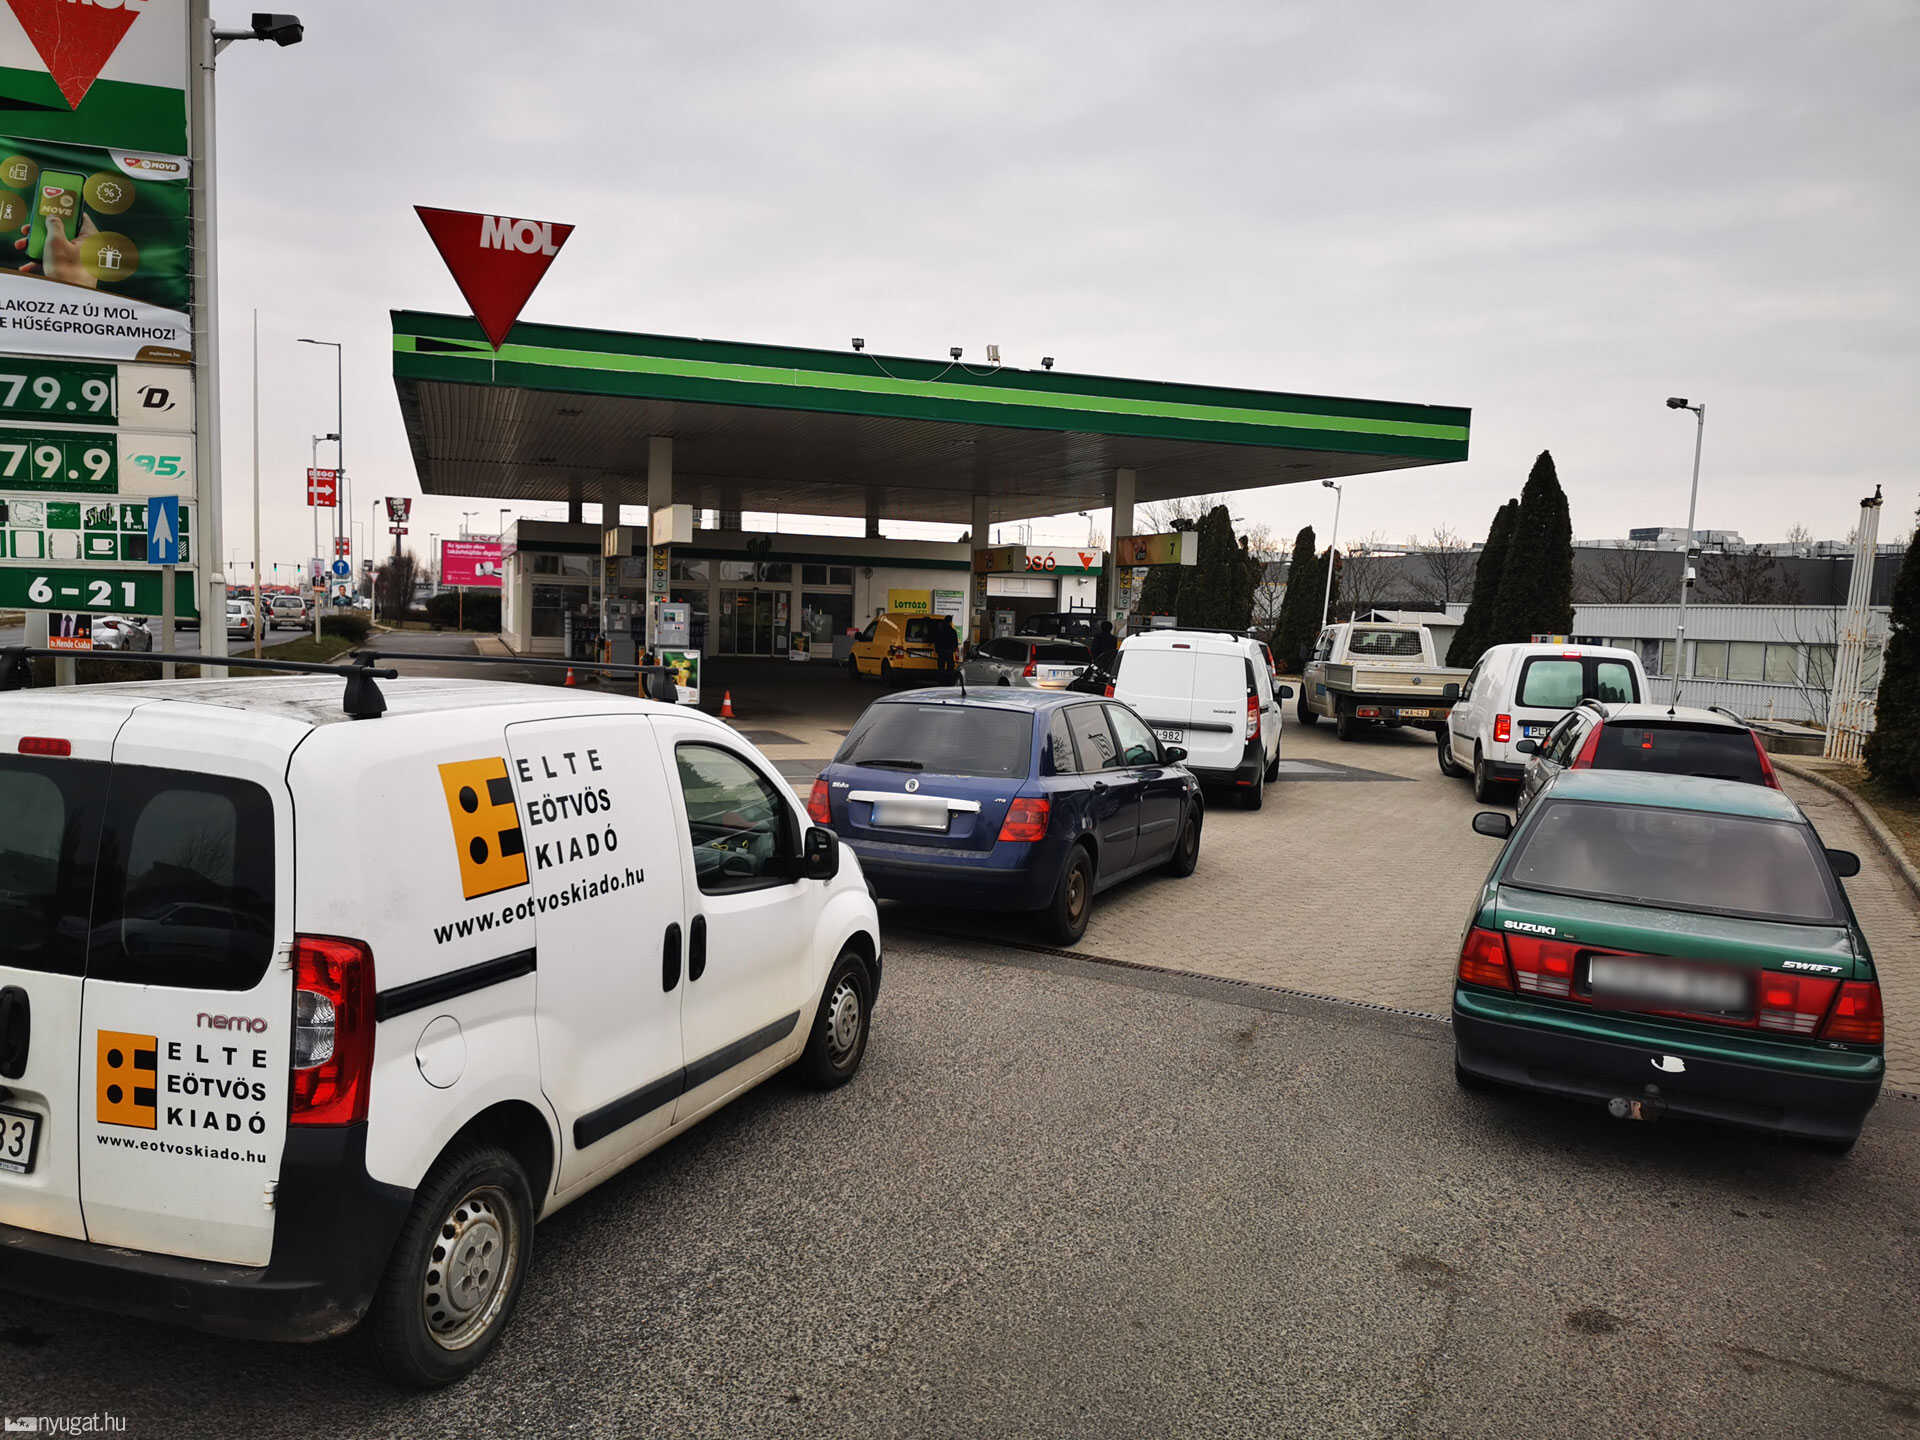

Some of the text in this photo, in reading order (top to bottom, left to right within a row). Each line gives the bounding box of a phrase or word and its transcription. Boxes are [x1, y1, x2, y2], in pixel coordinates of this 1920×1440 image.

[480, 215, 561, 257] MOL
[59, 303, 78, 317] AZ
[83, 302, 100, 318] ÚJ
[104, 307, 138, 321] MOL
[12, 315, 176, 341] HŰSÉGPROGRAMHOZ!
[86, 503, 114, 527] Shop
[516, 749, 602, 783] ELTE
[527, 786, 611, 826] EÖTVÖS
[535, 824, 618, 869] KIADÓ
[433, 867, 645, 945] www.eotvoskiado.hu
[1504, 920, 1556, 936] SUZUKI
[1782, 961, 1843, 974] SWIFT
[197, 1012, 268, 1034] nemo
[168, 1042, 267, 1068] ELTE
[167, 1072, 266, 1102] EÖTVÖS
[167, 1106, 266, 1134] KIADÓ
[97, 1134, 266, 1163] www.eotvoskiado.hu
